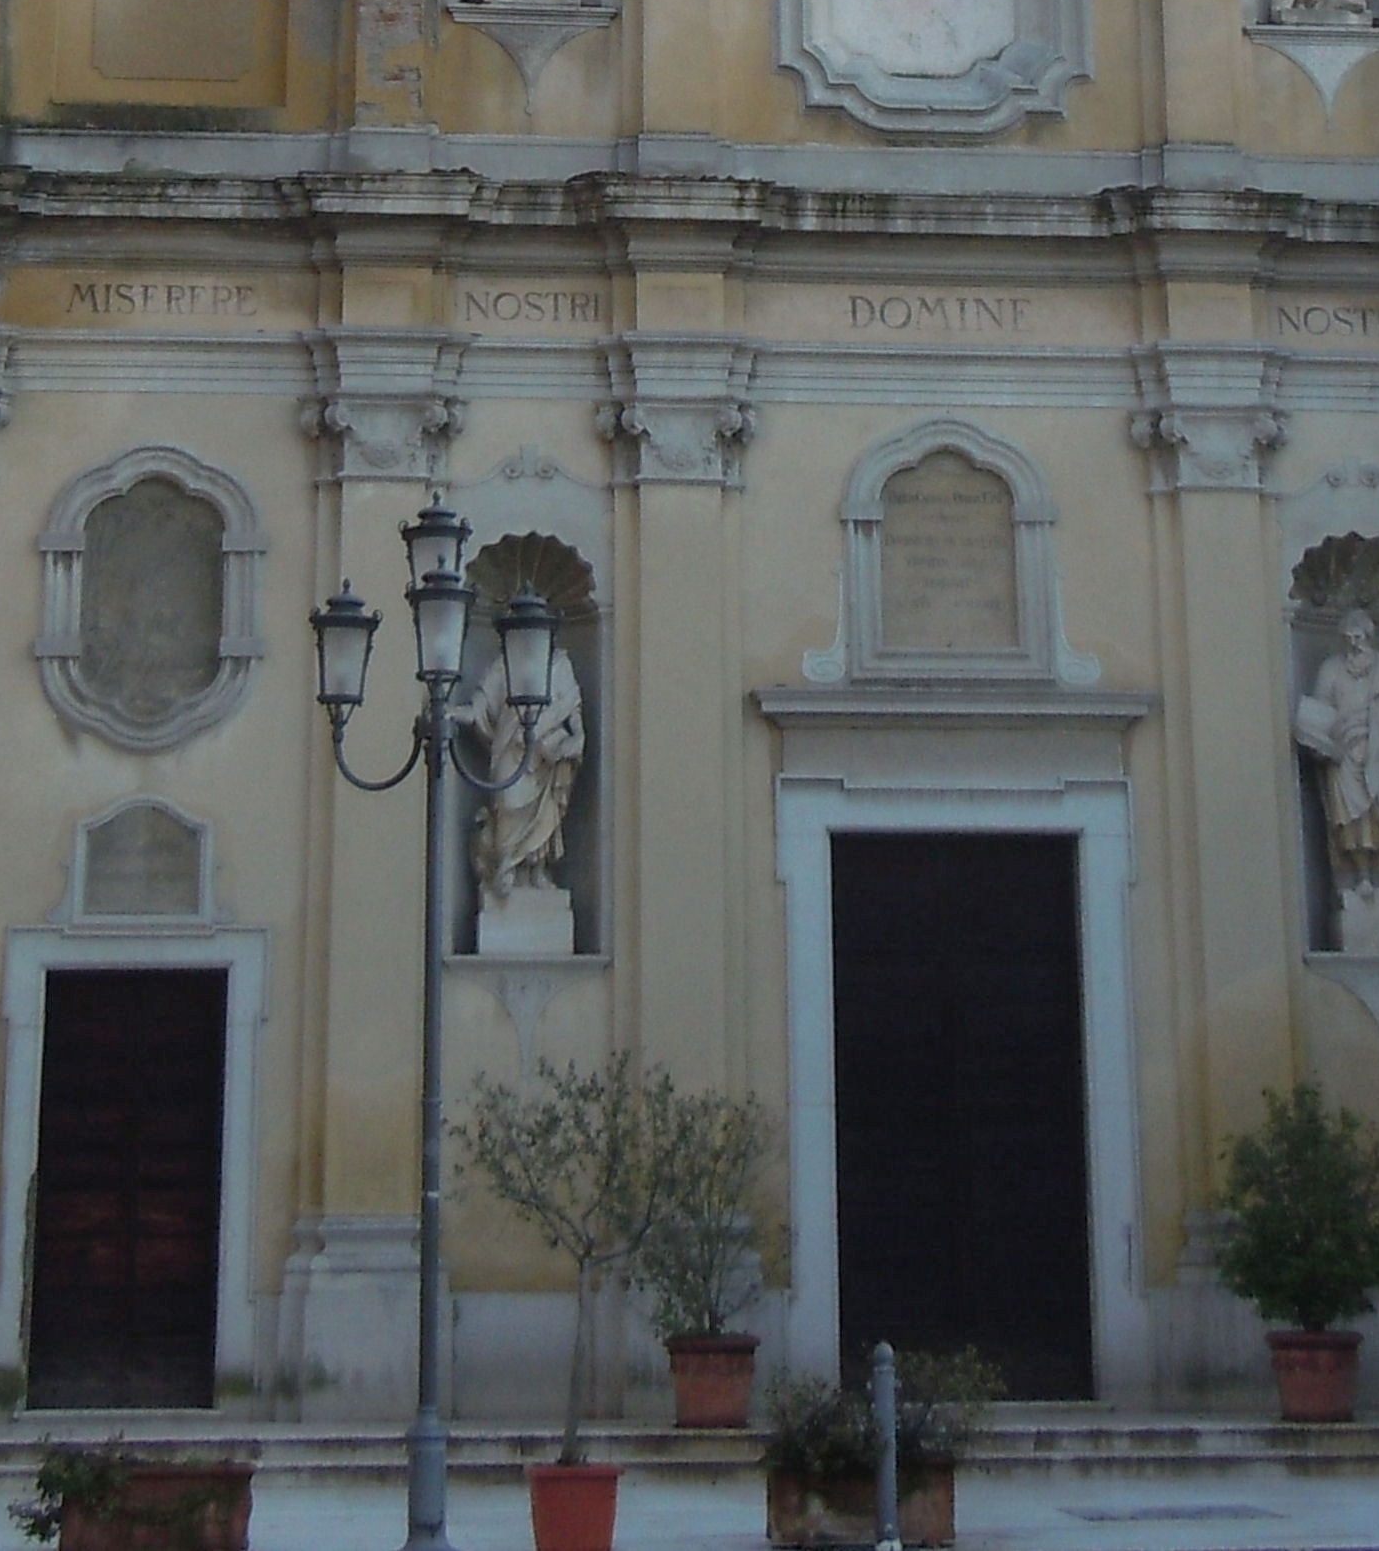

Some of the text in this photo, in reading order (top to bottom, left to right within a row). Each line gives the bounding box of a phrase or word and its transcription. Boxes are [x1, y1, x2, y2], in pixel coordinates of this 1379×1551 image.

[66, 282, 257, 316] MISERERE
[465, 290, 602, 323] NOSTRI
[850, 294, 1032, 332] DOMINE
